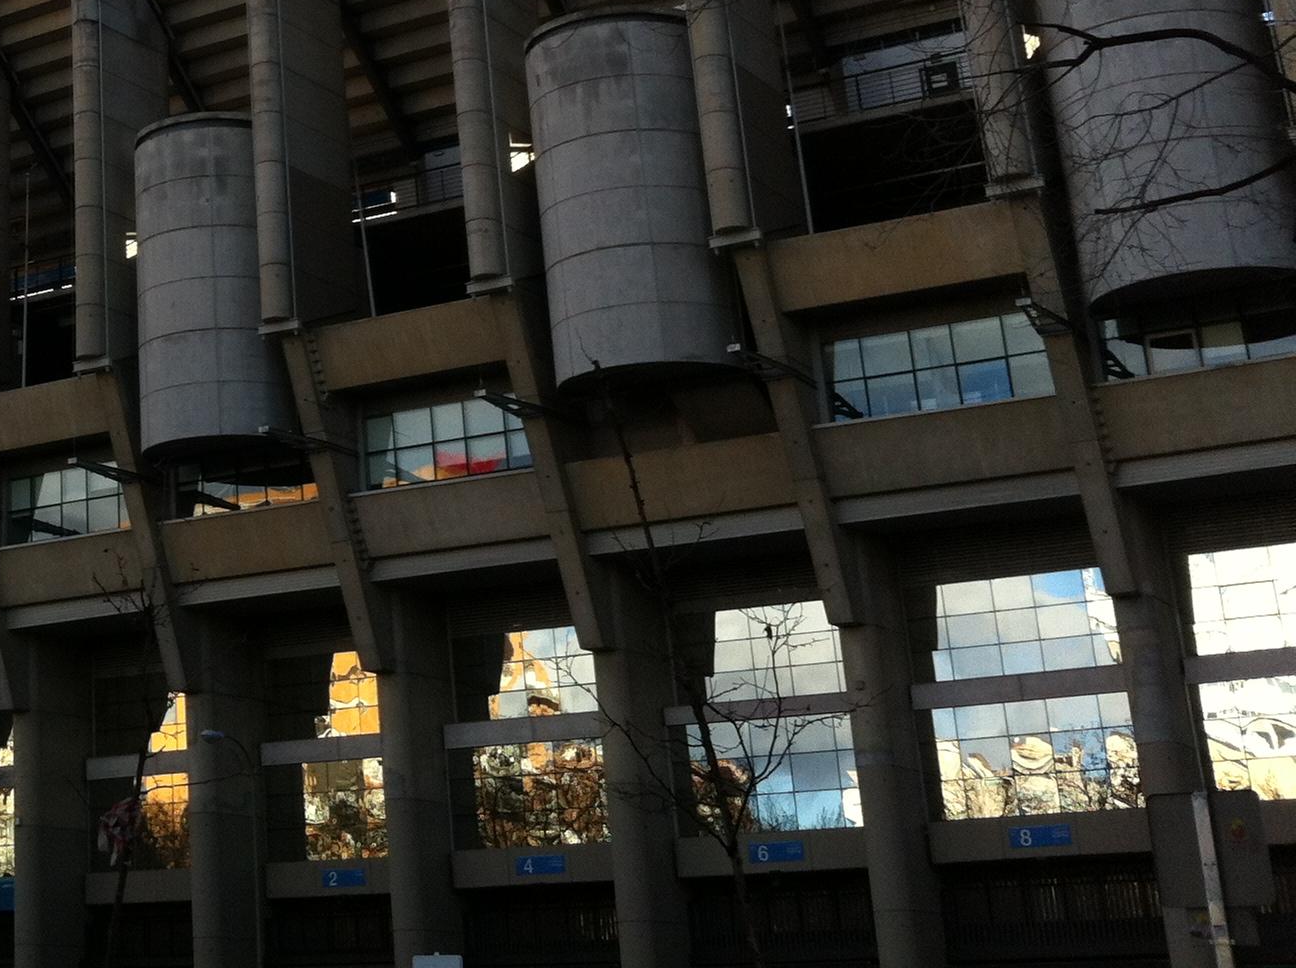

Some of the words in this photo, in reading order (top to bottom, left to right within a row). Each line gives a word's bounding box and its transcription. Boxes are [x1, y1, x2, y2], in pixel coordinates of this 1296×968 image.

[1019, 829, 1032, 846] 8
[757, 845, 769, 862] 6
[523, 859, 534, 874] 4
[328, 872, 338, 886] 2
